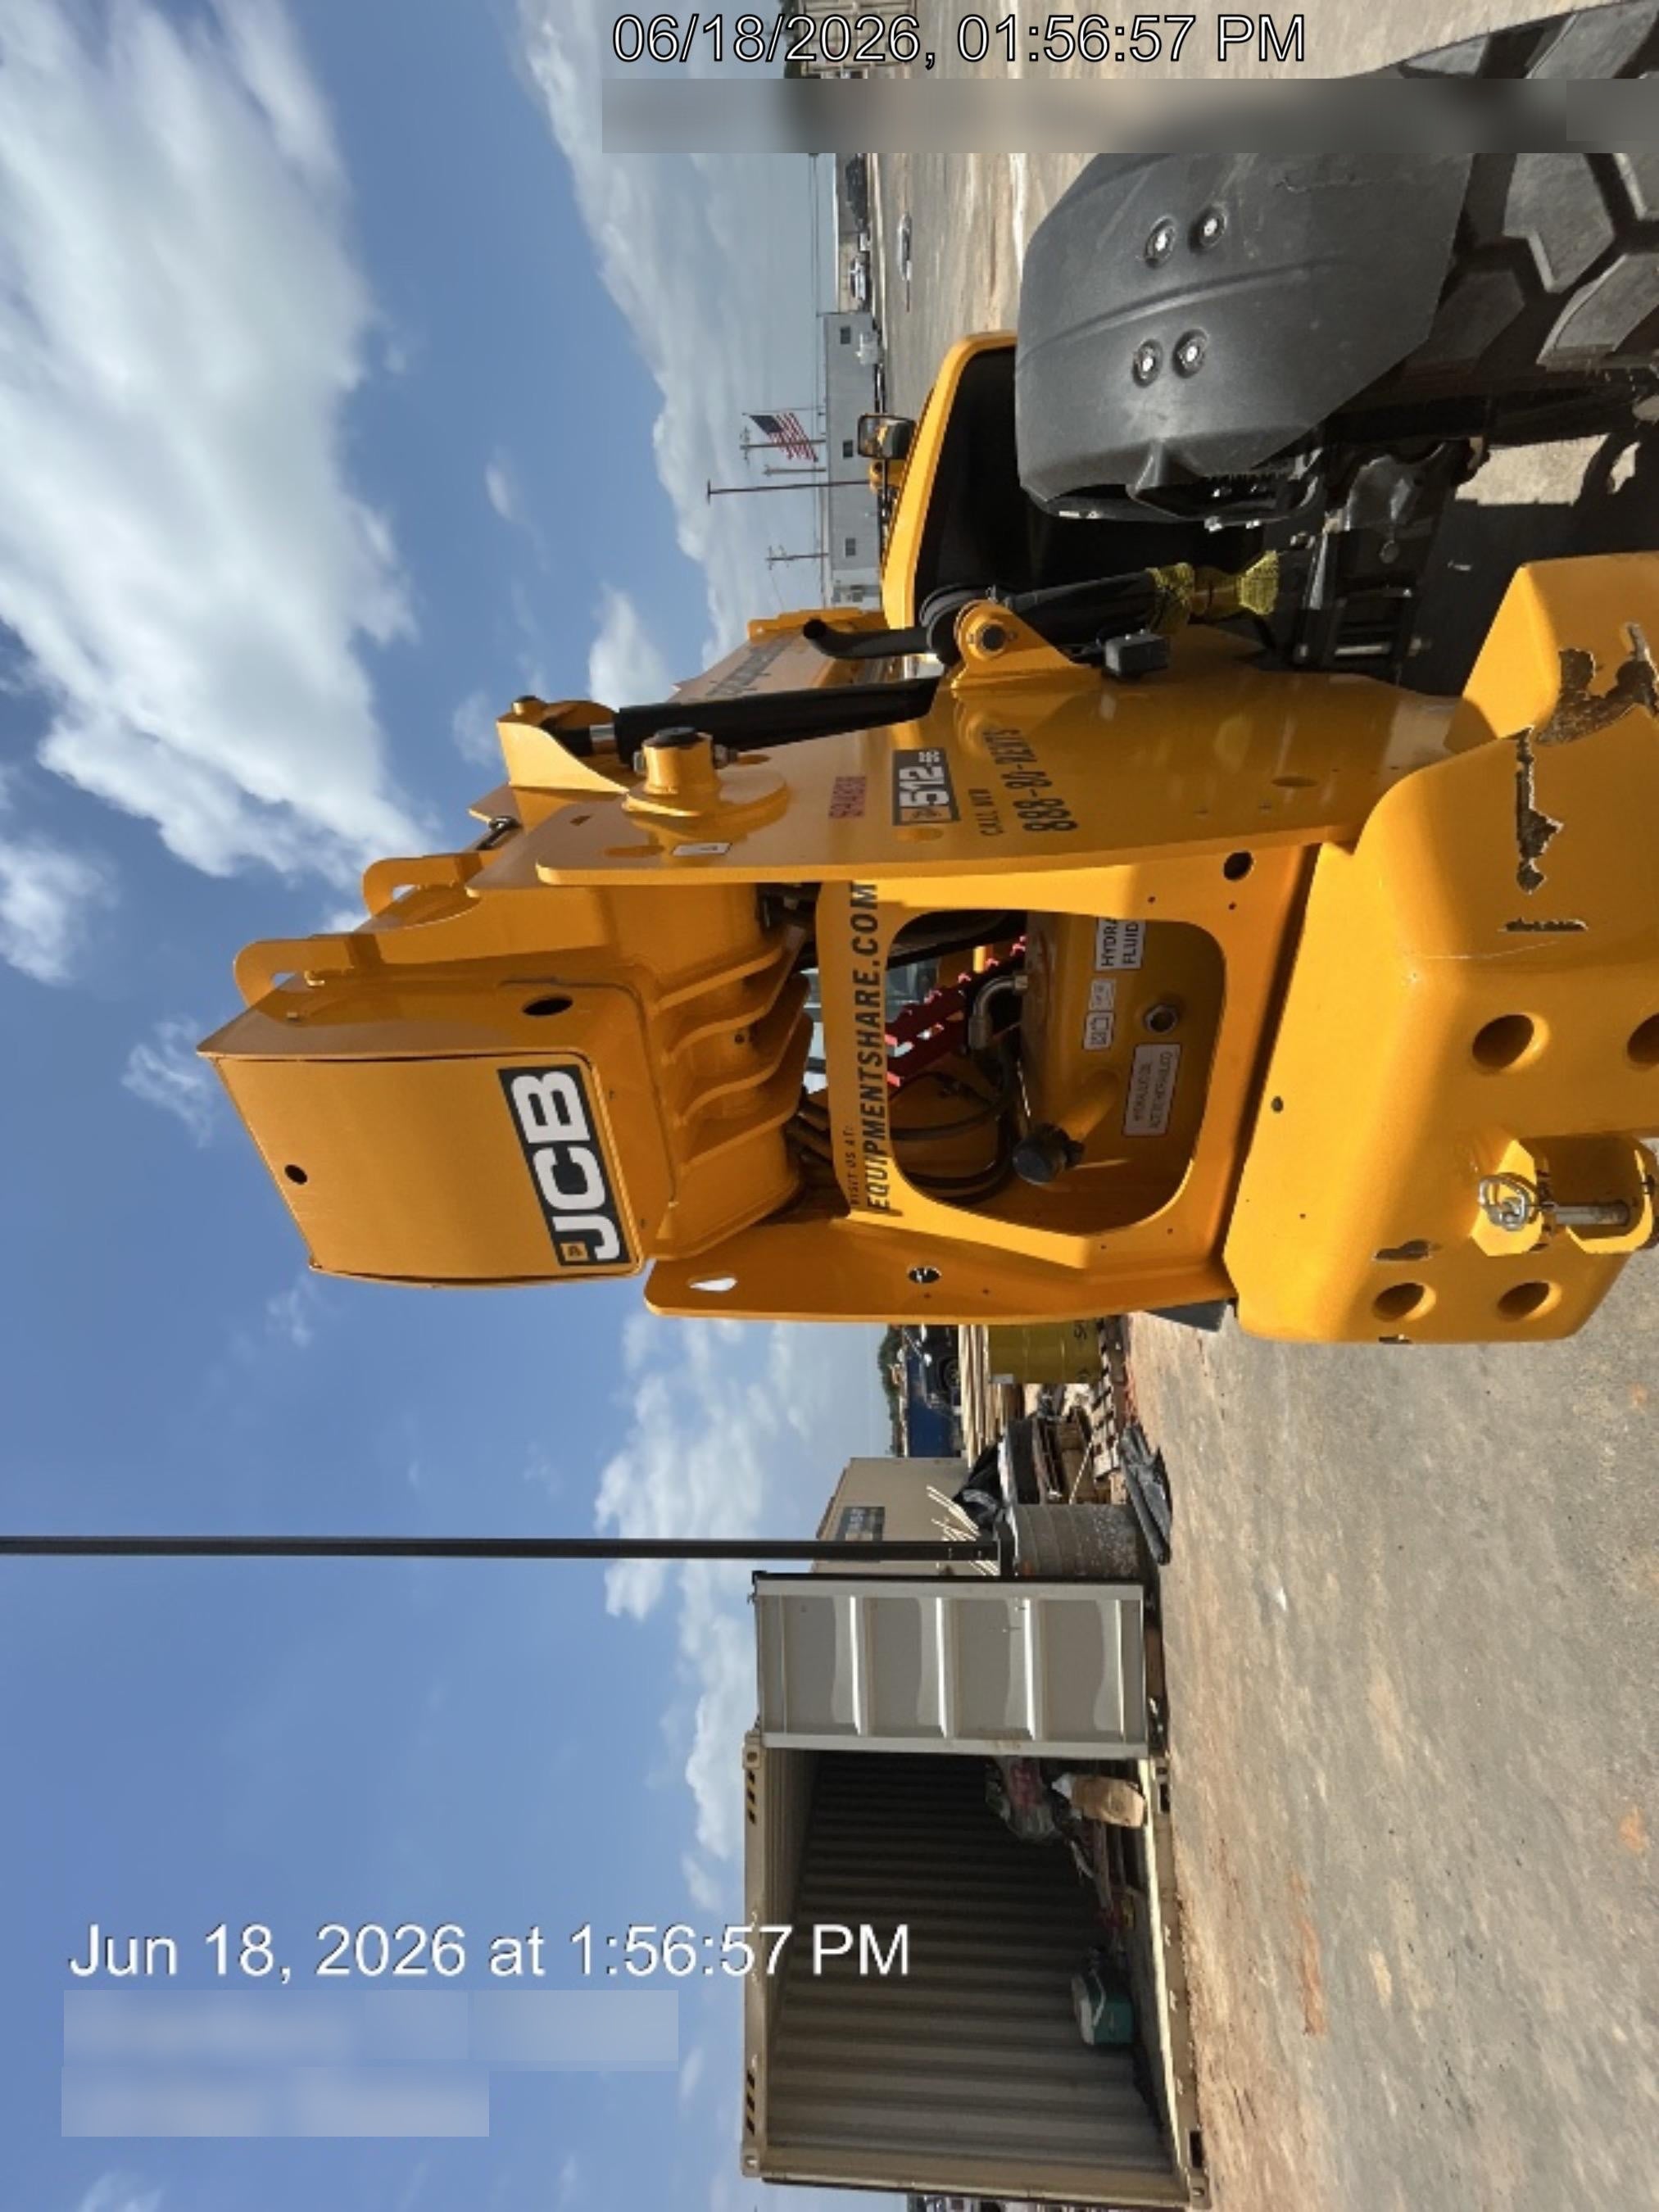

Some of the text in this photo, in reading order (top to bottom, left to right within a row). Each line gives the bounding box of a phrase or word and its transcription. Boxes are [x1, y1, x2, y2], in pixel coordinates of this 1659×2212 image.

[975, 810, 1004, 836] CALL
[982, 730, 1078, 832] 888-80-RENTS
[1123, 920, 1139, 964] FLUID
[850, 882, 890, 1209] EQUIPMENTSHARE.COM
[510, 1072, 621, 1260] JCB
[843, 1126, 859, 1207] VISIT US AT:
